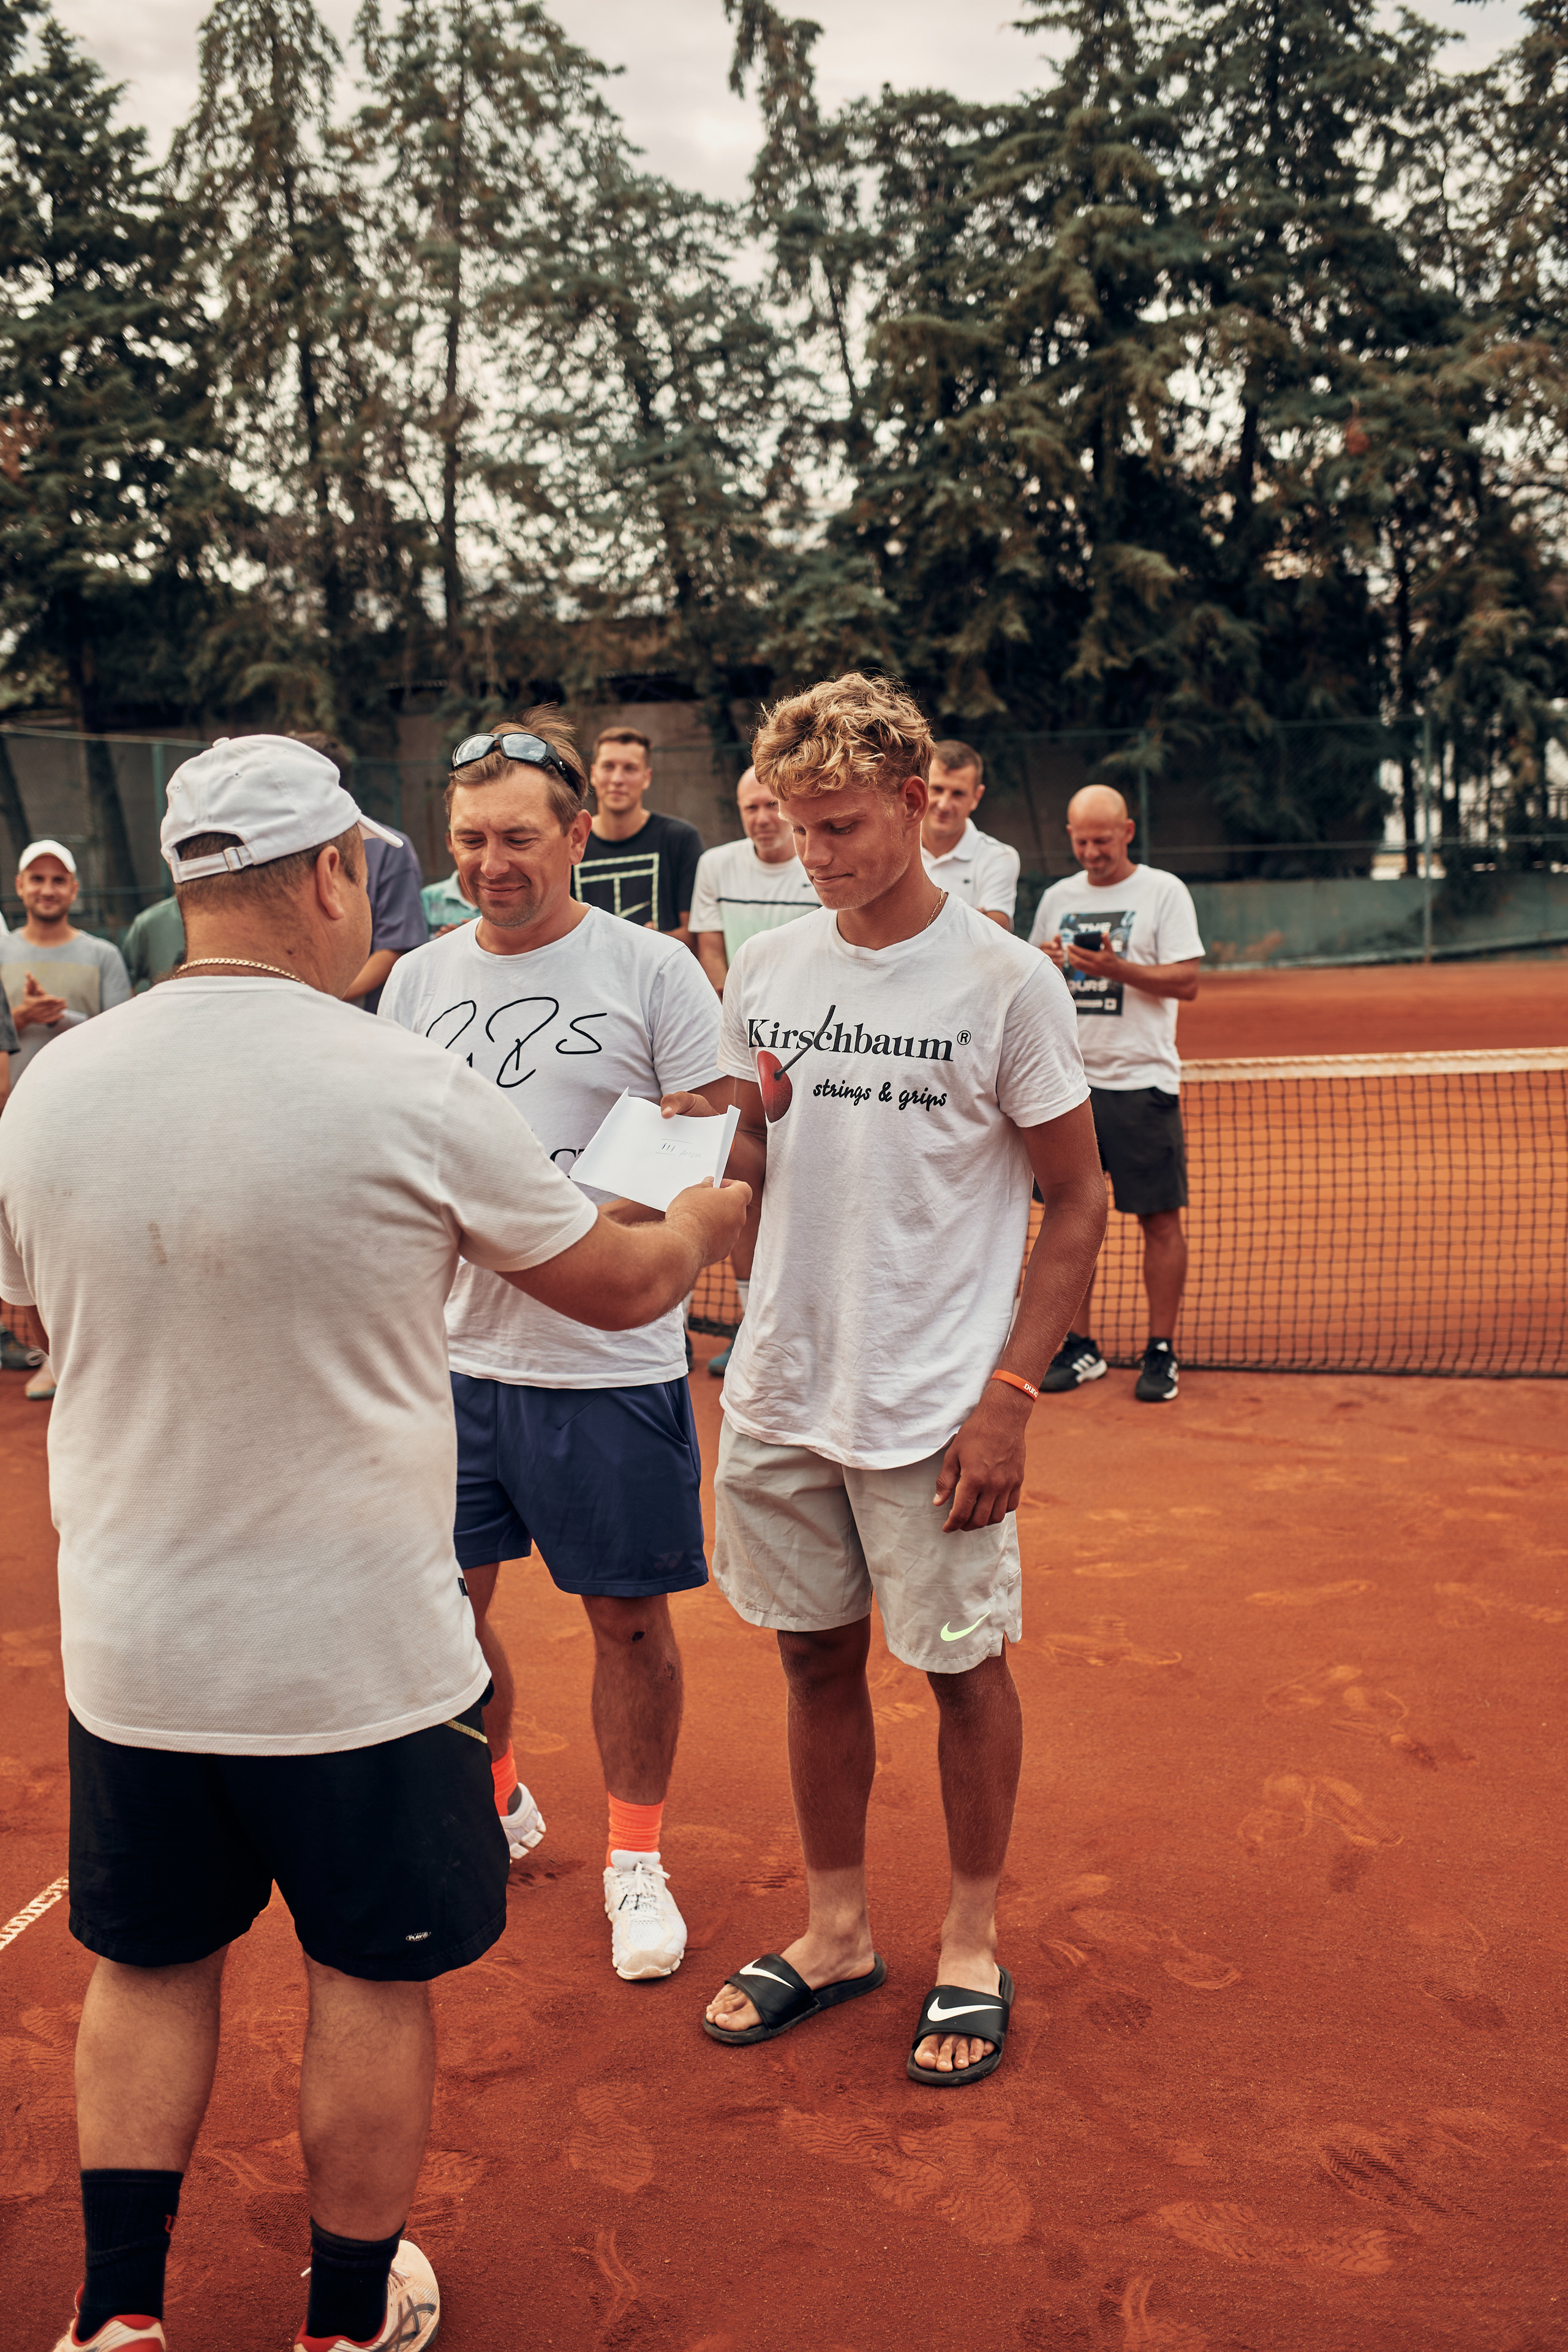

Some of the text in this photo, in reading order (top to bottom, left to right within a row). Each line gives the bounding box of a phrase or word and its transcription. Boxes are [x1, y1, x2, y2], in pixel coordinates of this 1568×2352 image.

[813, 1079, 948, 1112] strings & grips
